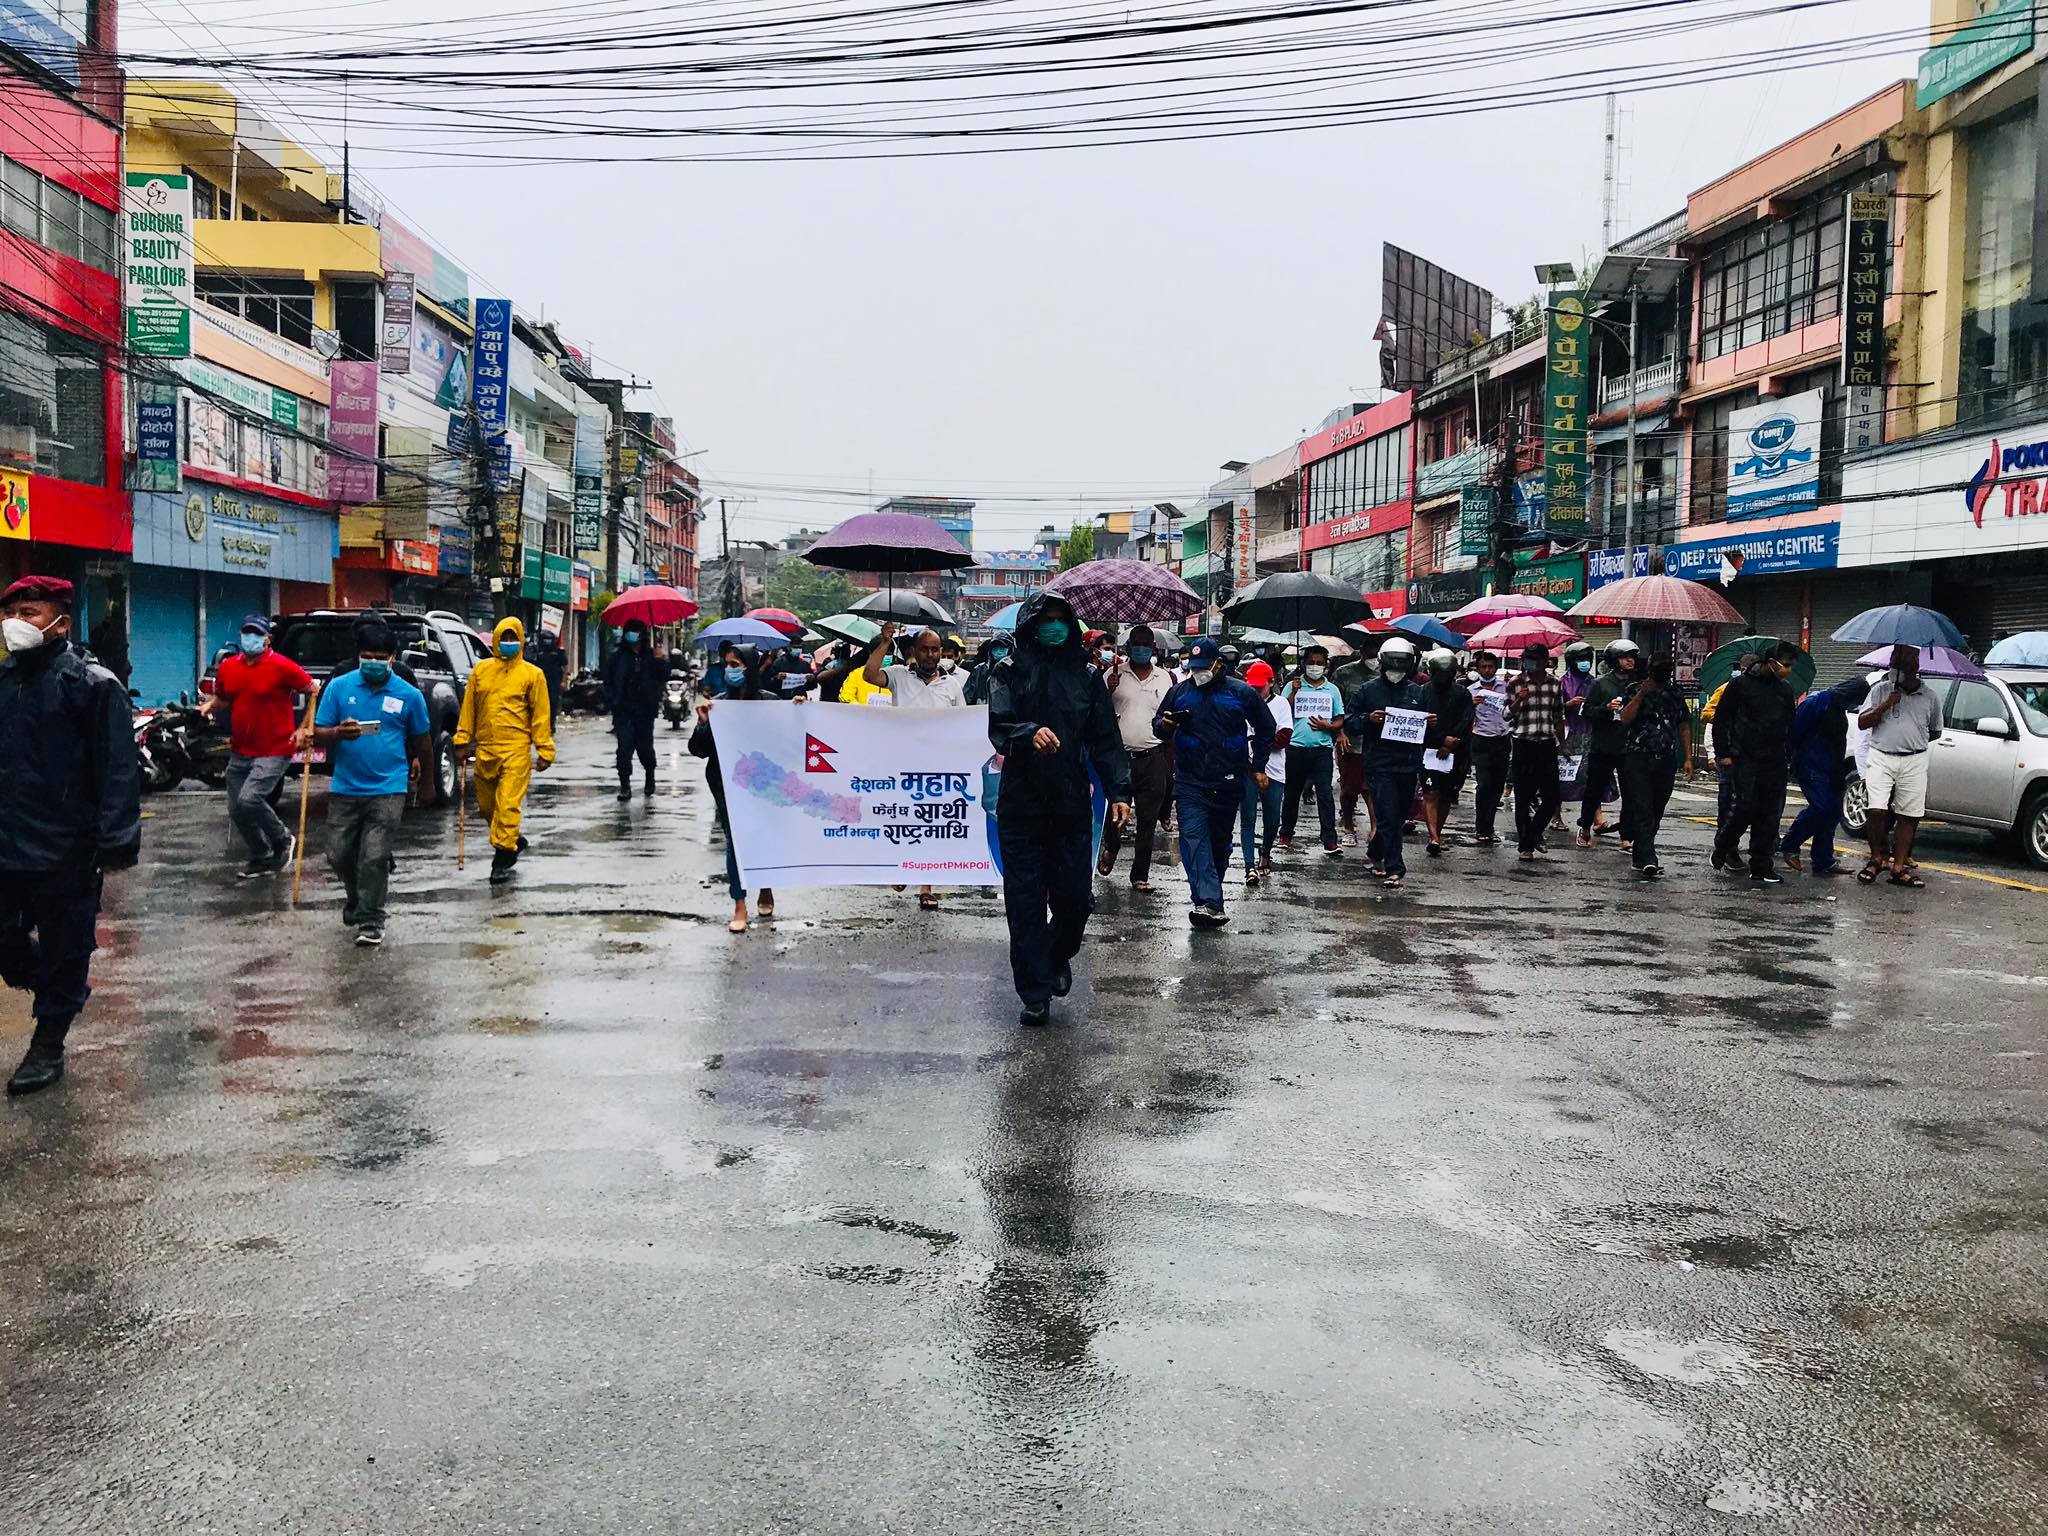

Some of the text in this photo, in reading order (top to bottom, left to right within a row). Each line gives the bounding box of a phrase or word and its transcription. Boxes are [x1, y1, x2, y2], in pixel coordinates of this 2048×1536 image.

[131, 212, 183, 233] GURUNG
[133, 239, 180, 259] BEAUTY
[129, 265, 186, 287] PARLOUR
[1788, 489, 1816, 502] CENTRE
[1681, 549, 1705, 567] DEEP
[1777, 535, 1825, 556] CENTRE
[850, 772, 976, 801] देशको मुहार
[872, 797, 968, 823] फेर्नु छ साथी
[824, 820, 969, 845] पार्टी भन्दा राष्ट्रमाथि
[902, 861, 990, 871] #SupportPMKPOli
